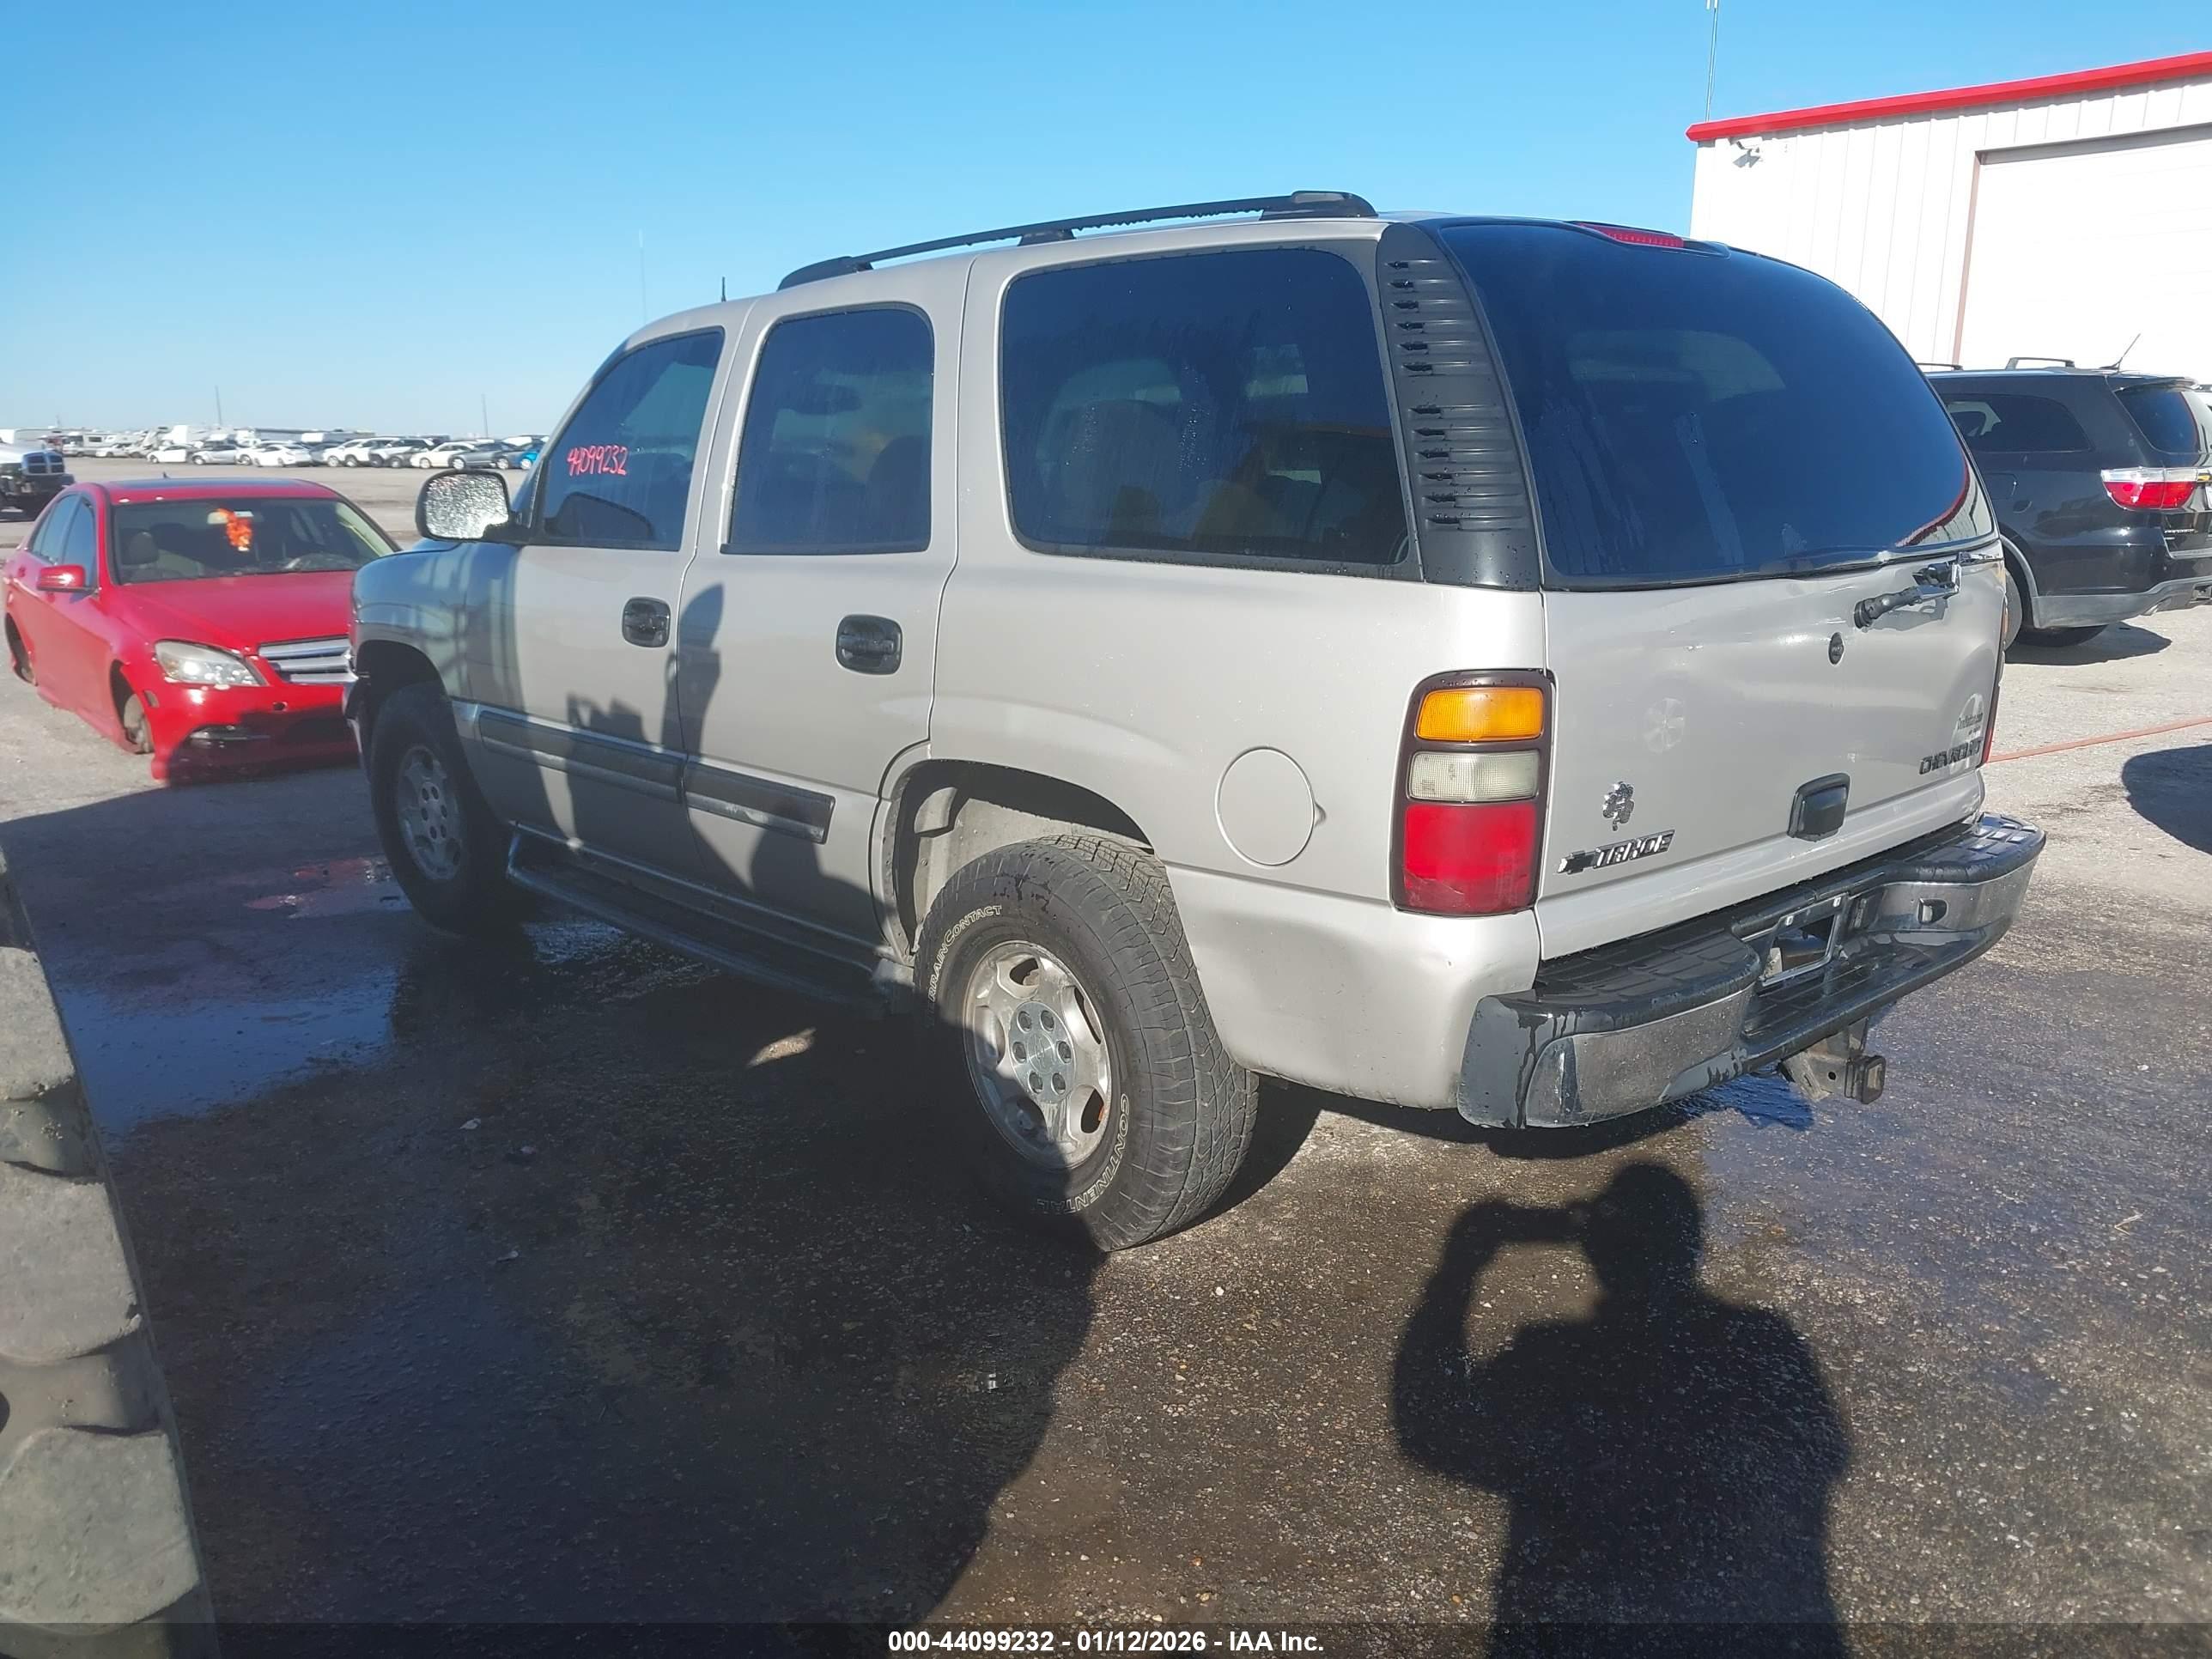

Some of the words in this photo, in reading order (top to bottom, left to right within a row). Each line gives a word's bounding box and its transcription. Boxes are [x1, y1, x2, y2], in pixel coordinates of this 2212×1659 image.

[567, 445, 629, 476] 44099232
[1594, 830, 1674, 869] TAHOE
[1037, 1093, 1129, 1215] CONTINENTAL
